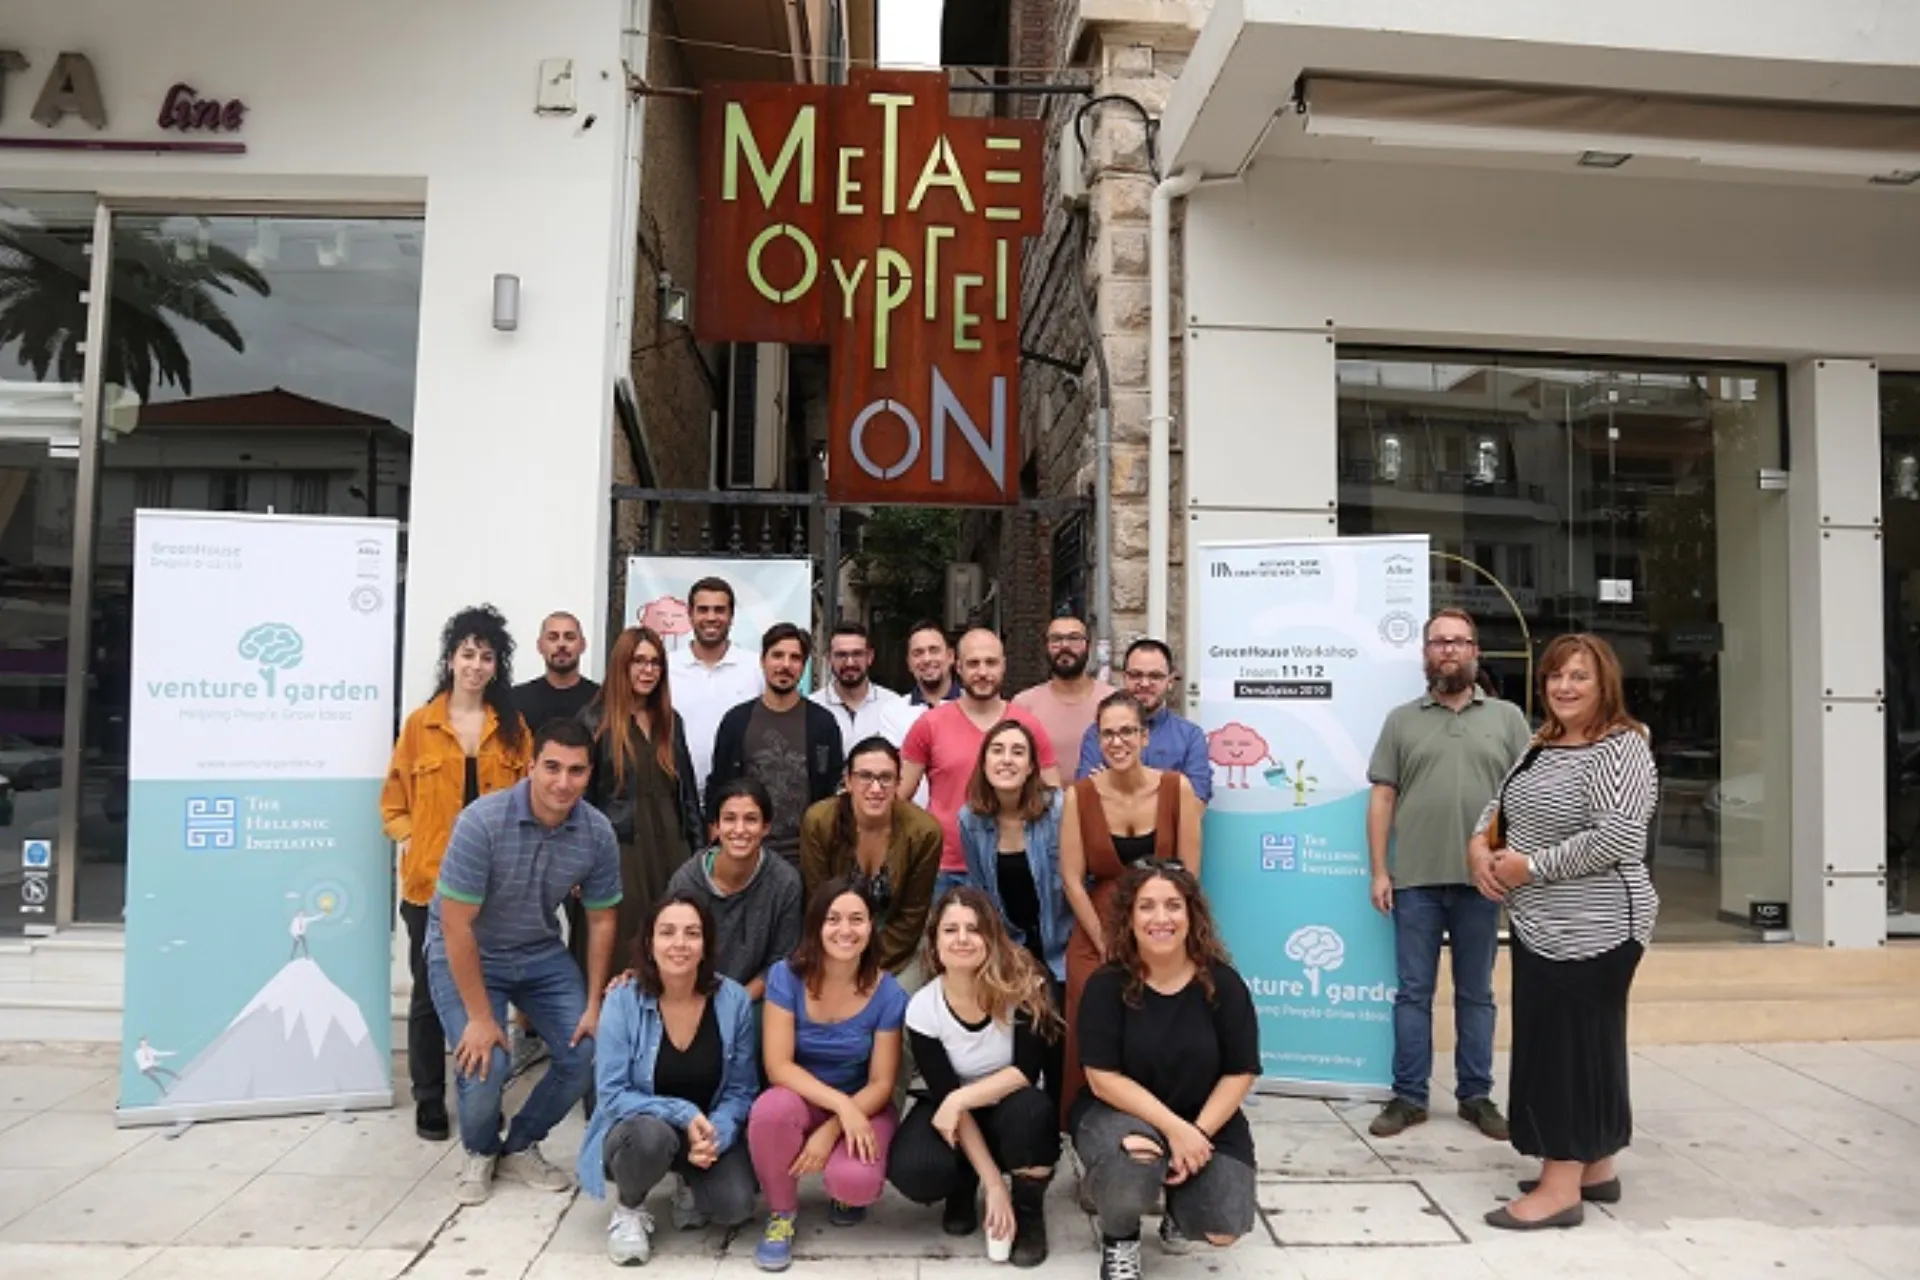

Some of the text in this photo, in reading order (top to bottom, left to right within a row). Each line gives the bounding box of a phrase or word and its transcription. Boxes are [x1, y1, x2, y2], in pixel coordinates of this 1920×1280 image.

[1208, 644, 1359, 660] GreenHouse Workshop
[147, 679, 379, 705] venture garden
[179, 708, 352, 723] Helping People Grow Ideas
[1325, 981, 1399, 1005] garde
